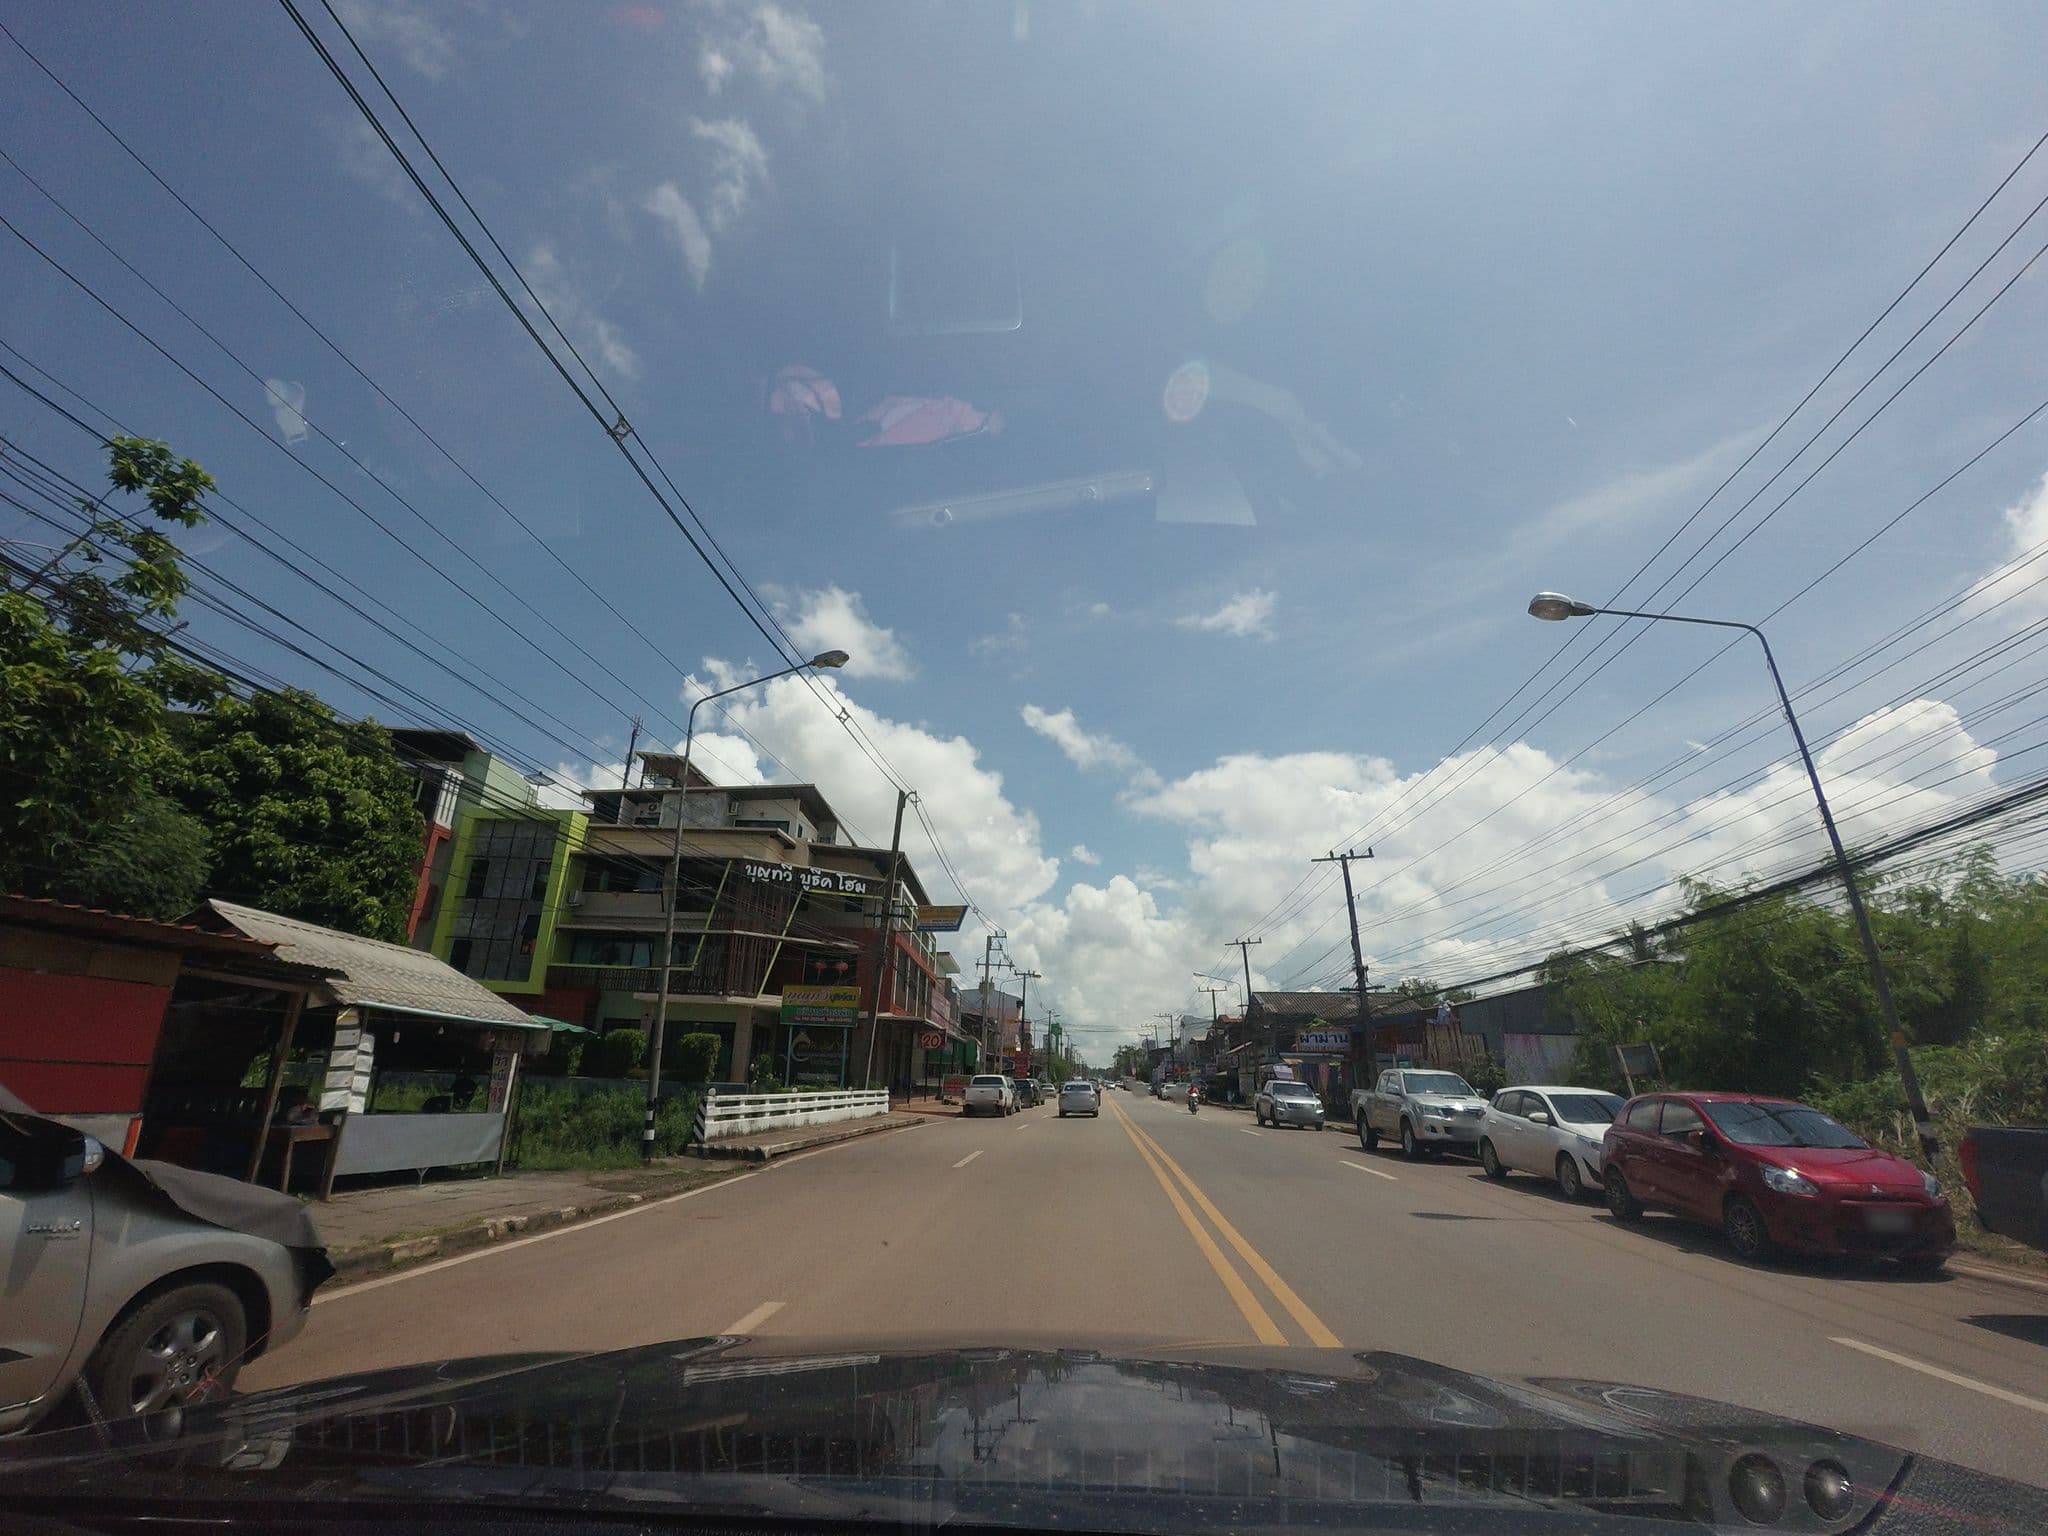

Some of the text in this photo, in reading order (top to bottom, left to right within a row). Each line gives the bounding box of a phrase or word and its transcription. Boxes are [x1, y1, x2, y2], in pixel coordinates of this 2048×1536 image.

[745, 862, 793, 882] บุญทวี
[835, 871, 866, 894] โฮม
[920, 1031, 941, 1047] 20
[1299, 1028, 1349, 1044] ผ้าม่าน
